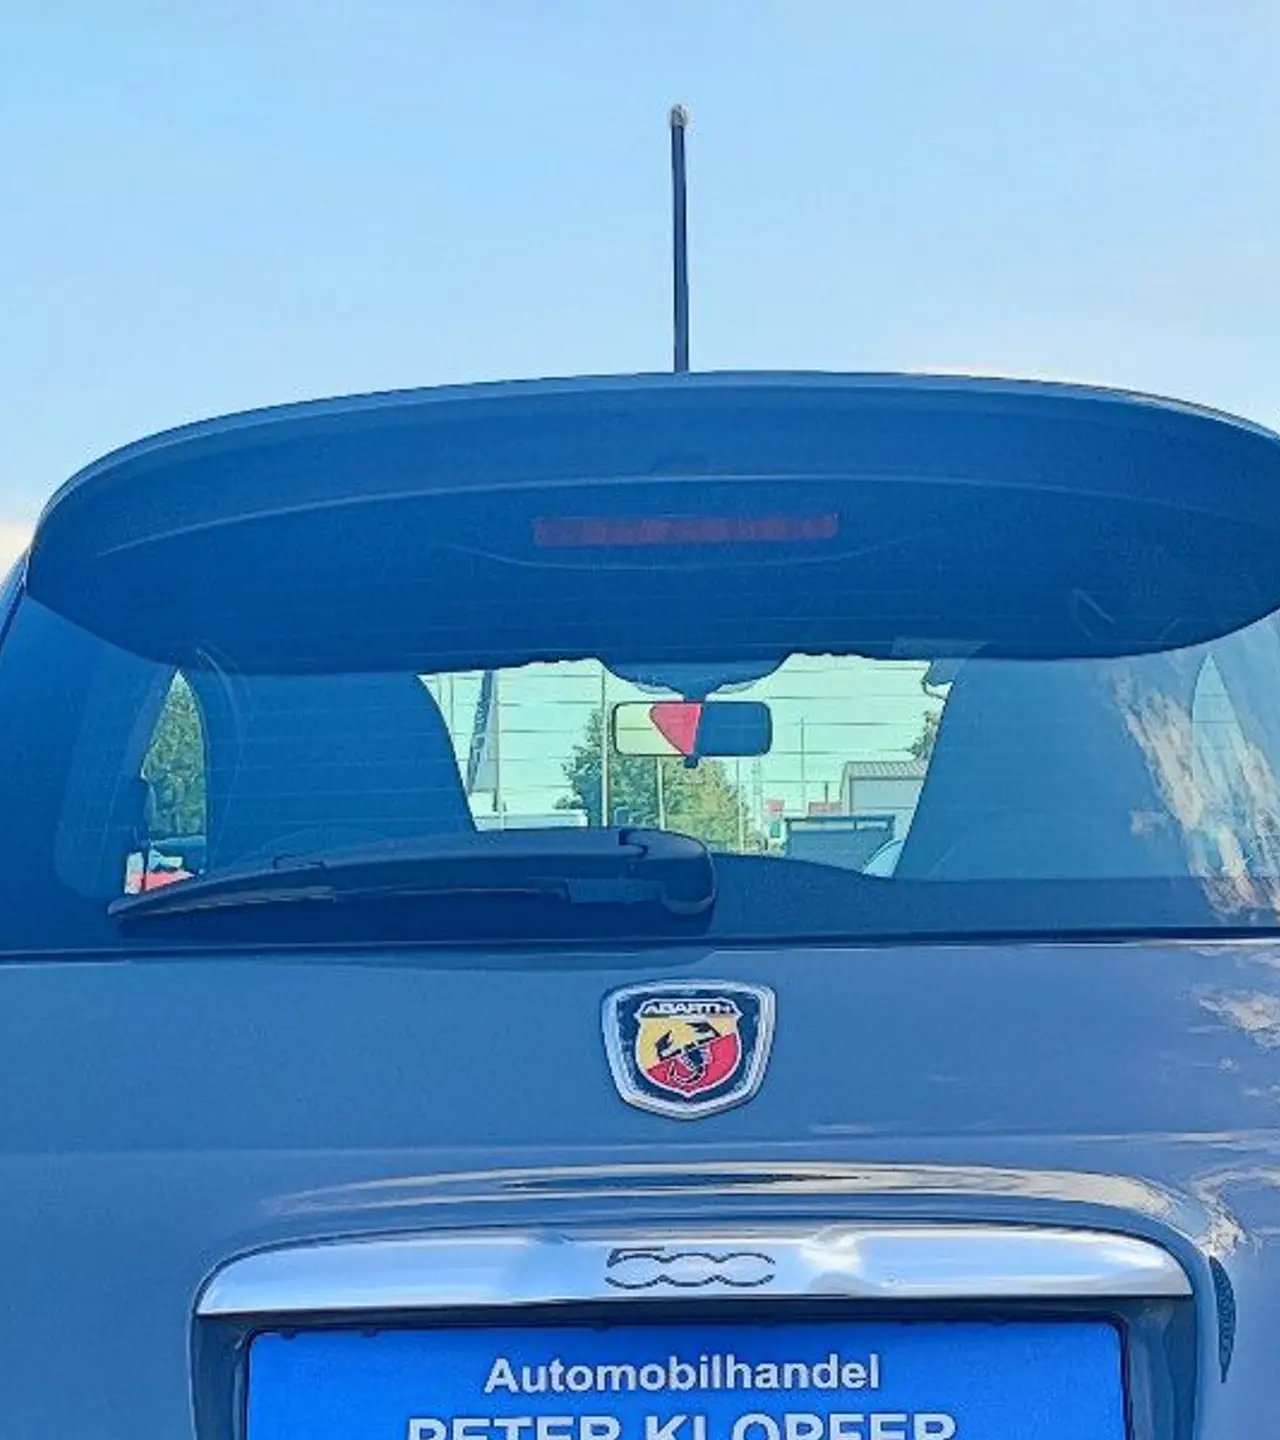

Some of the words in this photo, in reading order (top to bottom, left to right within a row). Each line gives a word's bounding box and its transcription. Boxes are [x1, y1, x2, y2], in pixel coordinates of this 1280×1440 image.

[642, 1001, 733, 1015] ABARTH
[604, 1246, 776, 1290] 500
[483, 1353, 880, 1394] Automobilhandel
